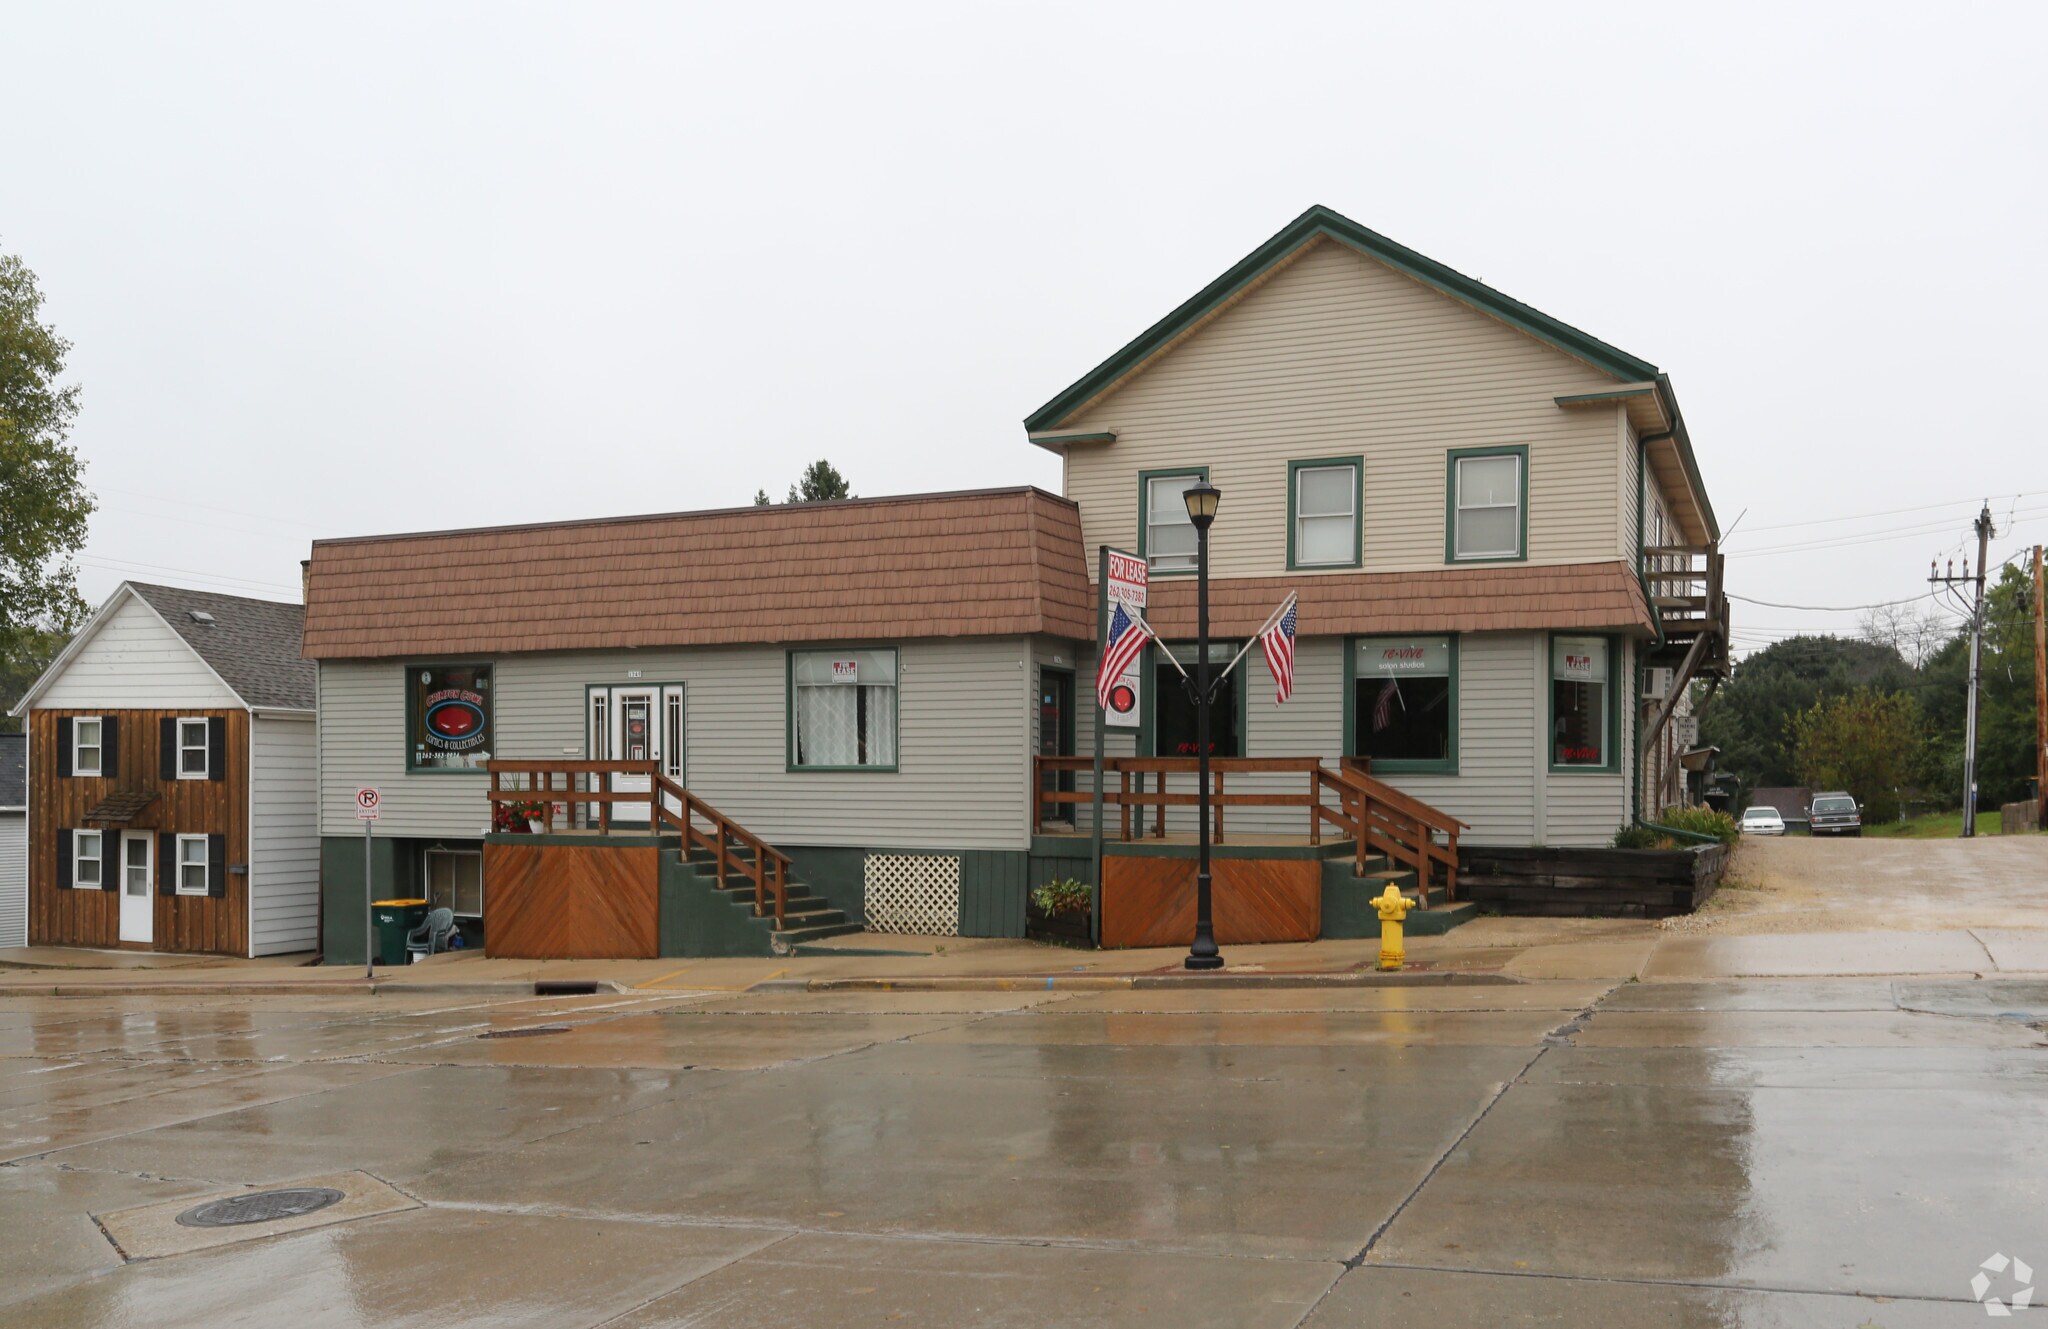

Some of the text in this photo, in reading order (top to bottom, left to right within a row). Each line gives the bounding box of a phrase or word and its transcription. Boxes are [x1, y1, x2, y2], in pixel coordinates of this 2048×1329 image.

[1110, 556, 1146, 584] FOR LEASE
[1399, 661, 1425, 669] studios
[1566, 661, 1590, 671] LEASE
[833, 667, 856, 675] LEASE
[425, 734, 444, 748] COMICS
[449, 733, 486, 750] COLLECTIBLES
